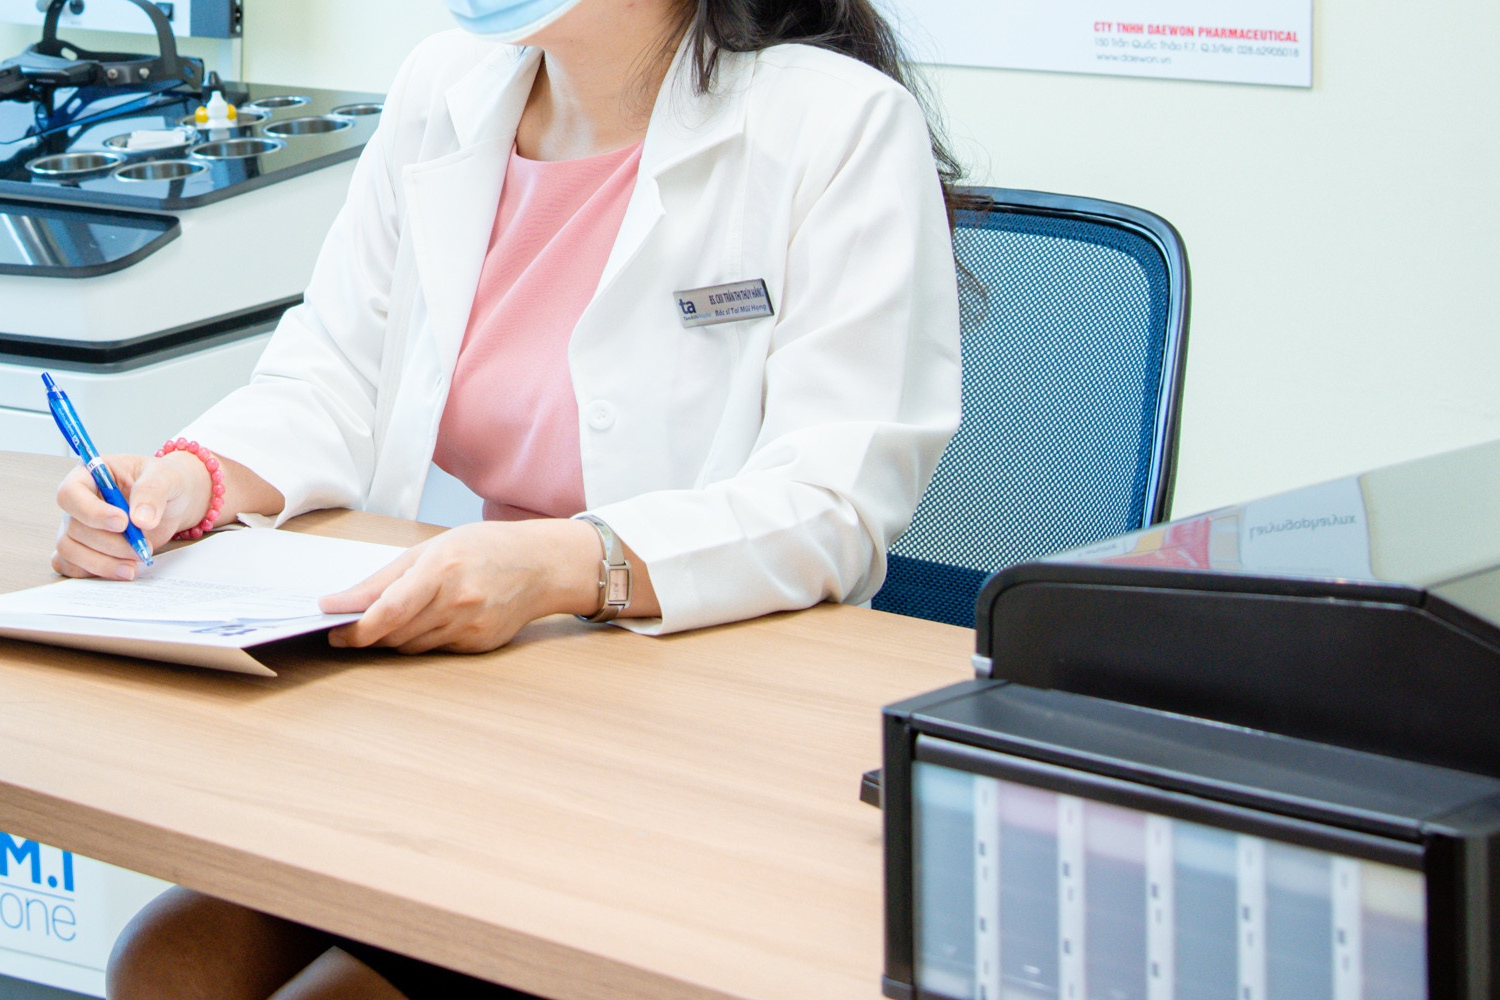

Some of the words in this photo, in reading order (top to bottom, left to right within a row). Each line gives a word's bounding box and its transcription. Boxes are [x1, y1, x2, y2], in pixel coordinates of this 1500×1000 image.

[1093, 20, 1112, 33] CTY
[1116, 22, 1145, 35] TNHH
[1147, 23, 1195, 37] DAEWON
[1198, 26, 1299, 43] PHARMACEUTICAL
[679, 298, 697, 315] ta
[0, 892, 77, 942] one
